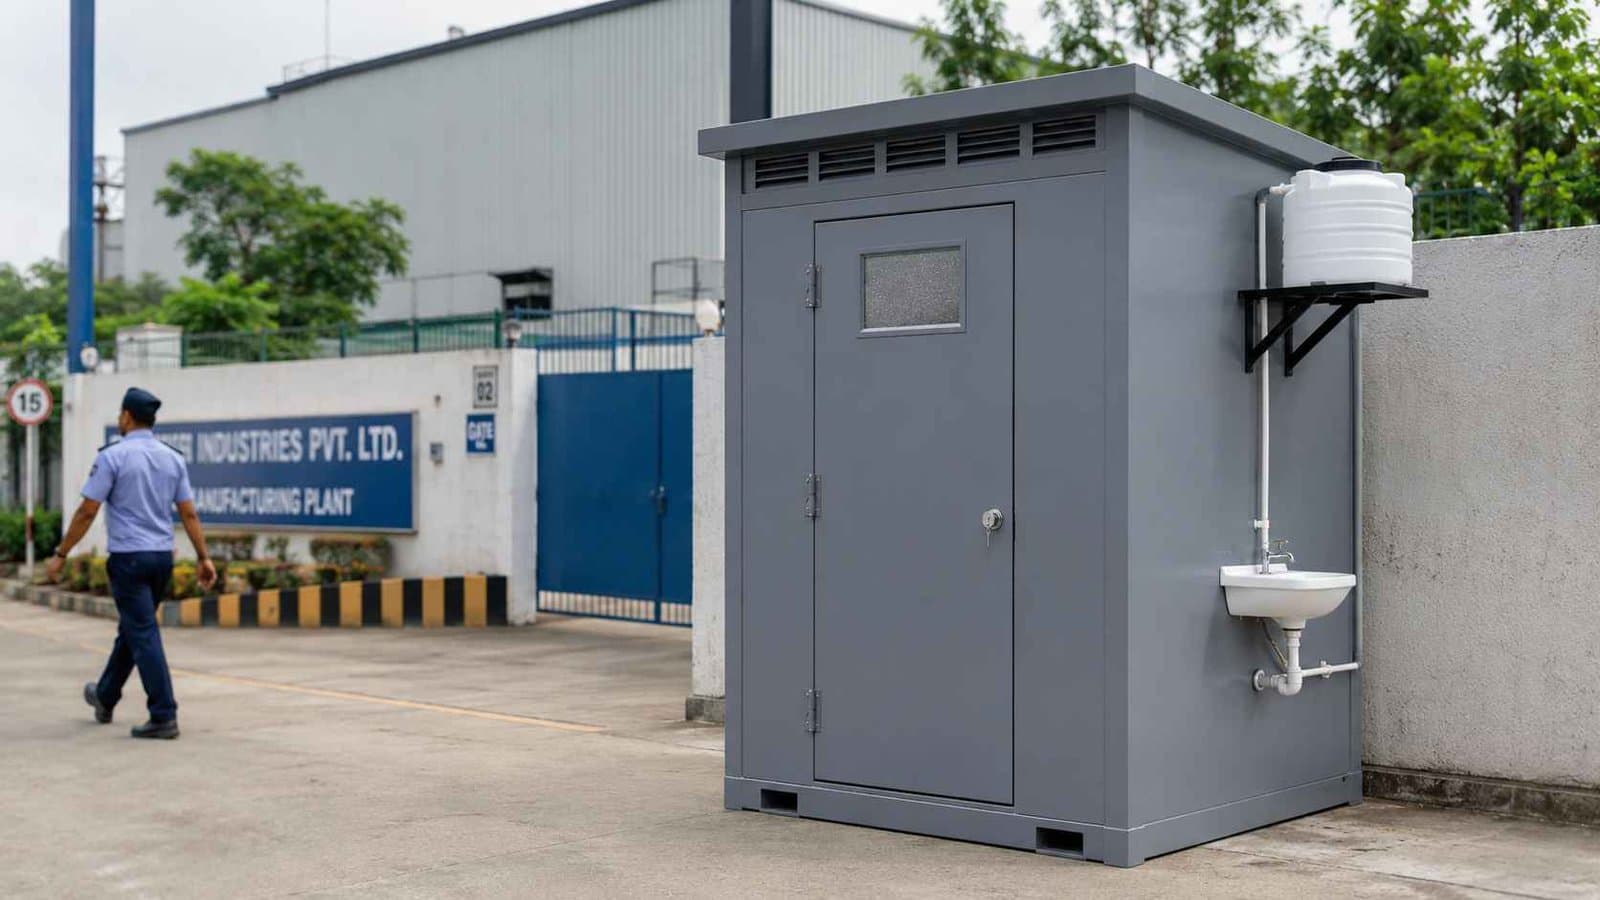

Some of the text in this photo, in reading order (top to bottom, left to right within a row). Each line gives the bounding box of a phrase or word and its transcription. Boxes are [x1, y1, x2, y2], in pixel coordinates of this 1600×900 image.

[18, 392, 42, 412] 15
[468, 421, 493, 440] GATE
[197, 429, 303, 463] INDUSTRIES
[308, 427, 352, 462] PVT.
[358, 425, 403, 461] LTD.
[304, 487, 354, 516] PLANT
